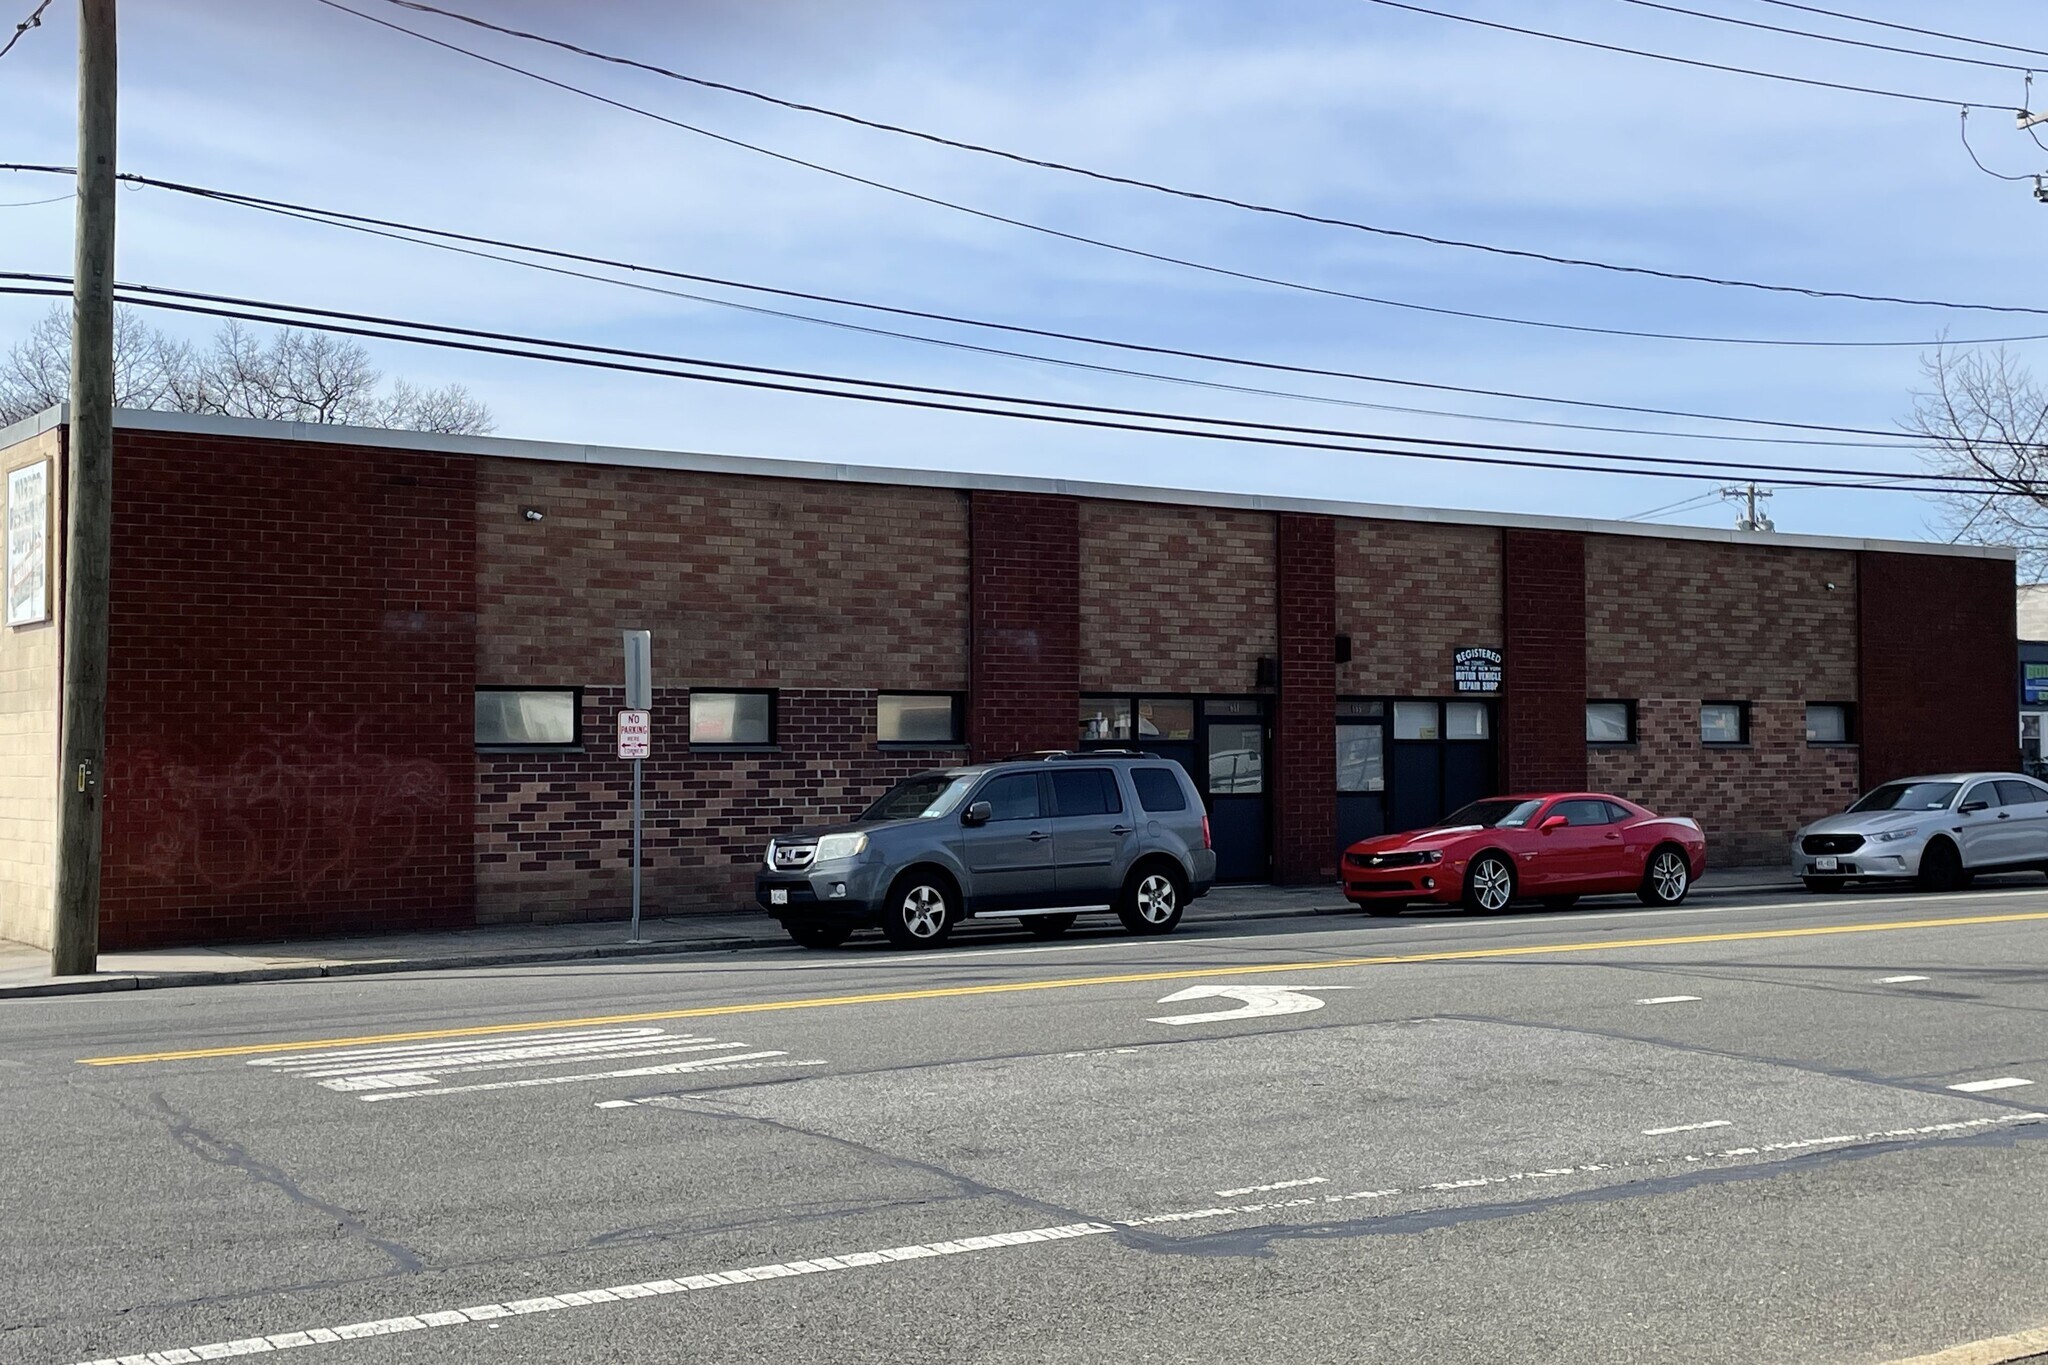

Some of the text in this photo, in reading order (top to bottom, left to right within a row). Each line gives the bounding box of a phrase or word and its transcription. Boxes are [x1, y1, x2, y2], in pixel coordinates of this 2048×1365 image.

[1456, 648, 1501, 663] REGISTERED
[1455, 671, 1502, 681] MOTOR VEHICLE
[1459, 681, 1498, 690] REPAIR SHOP
[628, 715, 640, 723] NO
[621, 725, 647, 734] PARKING
